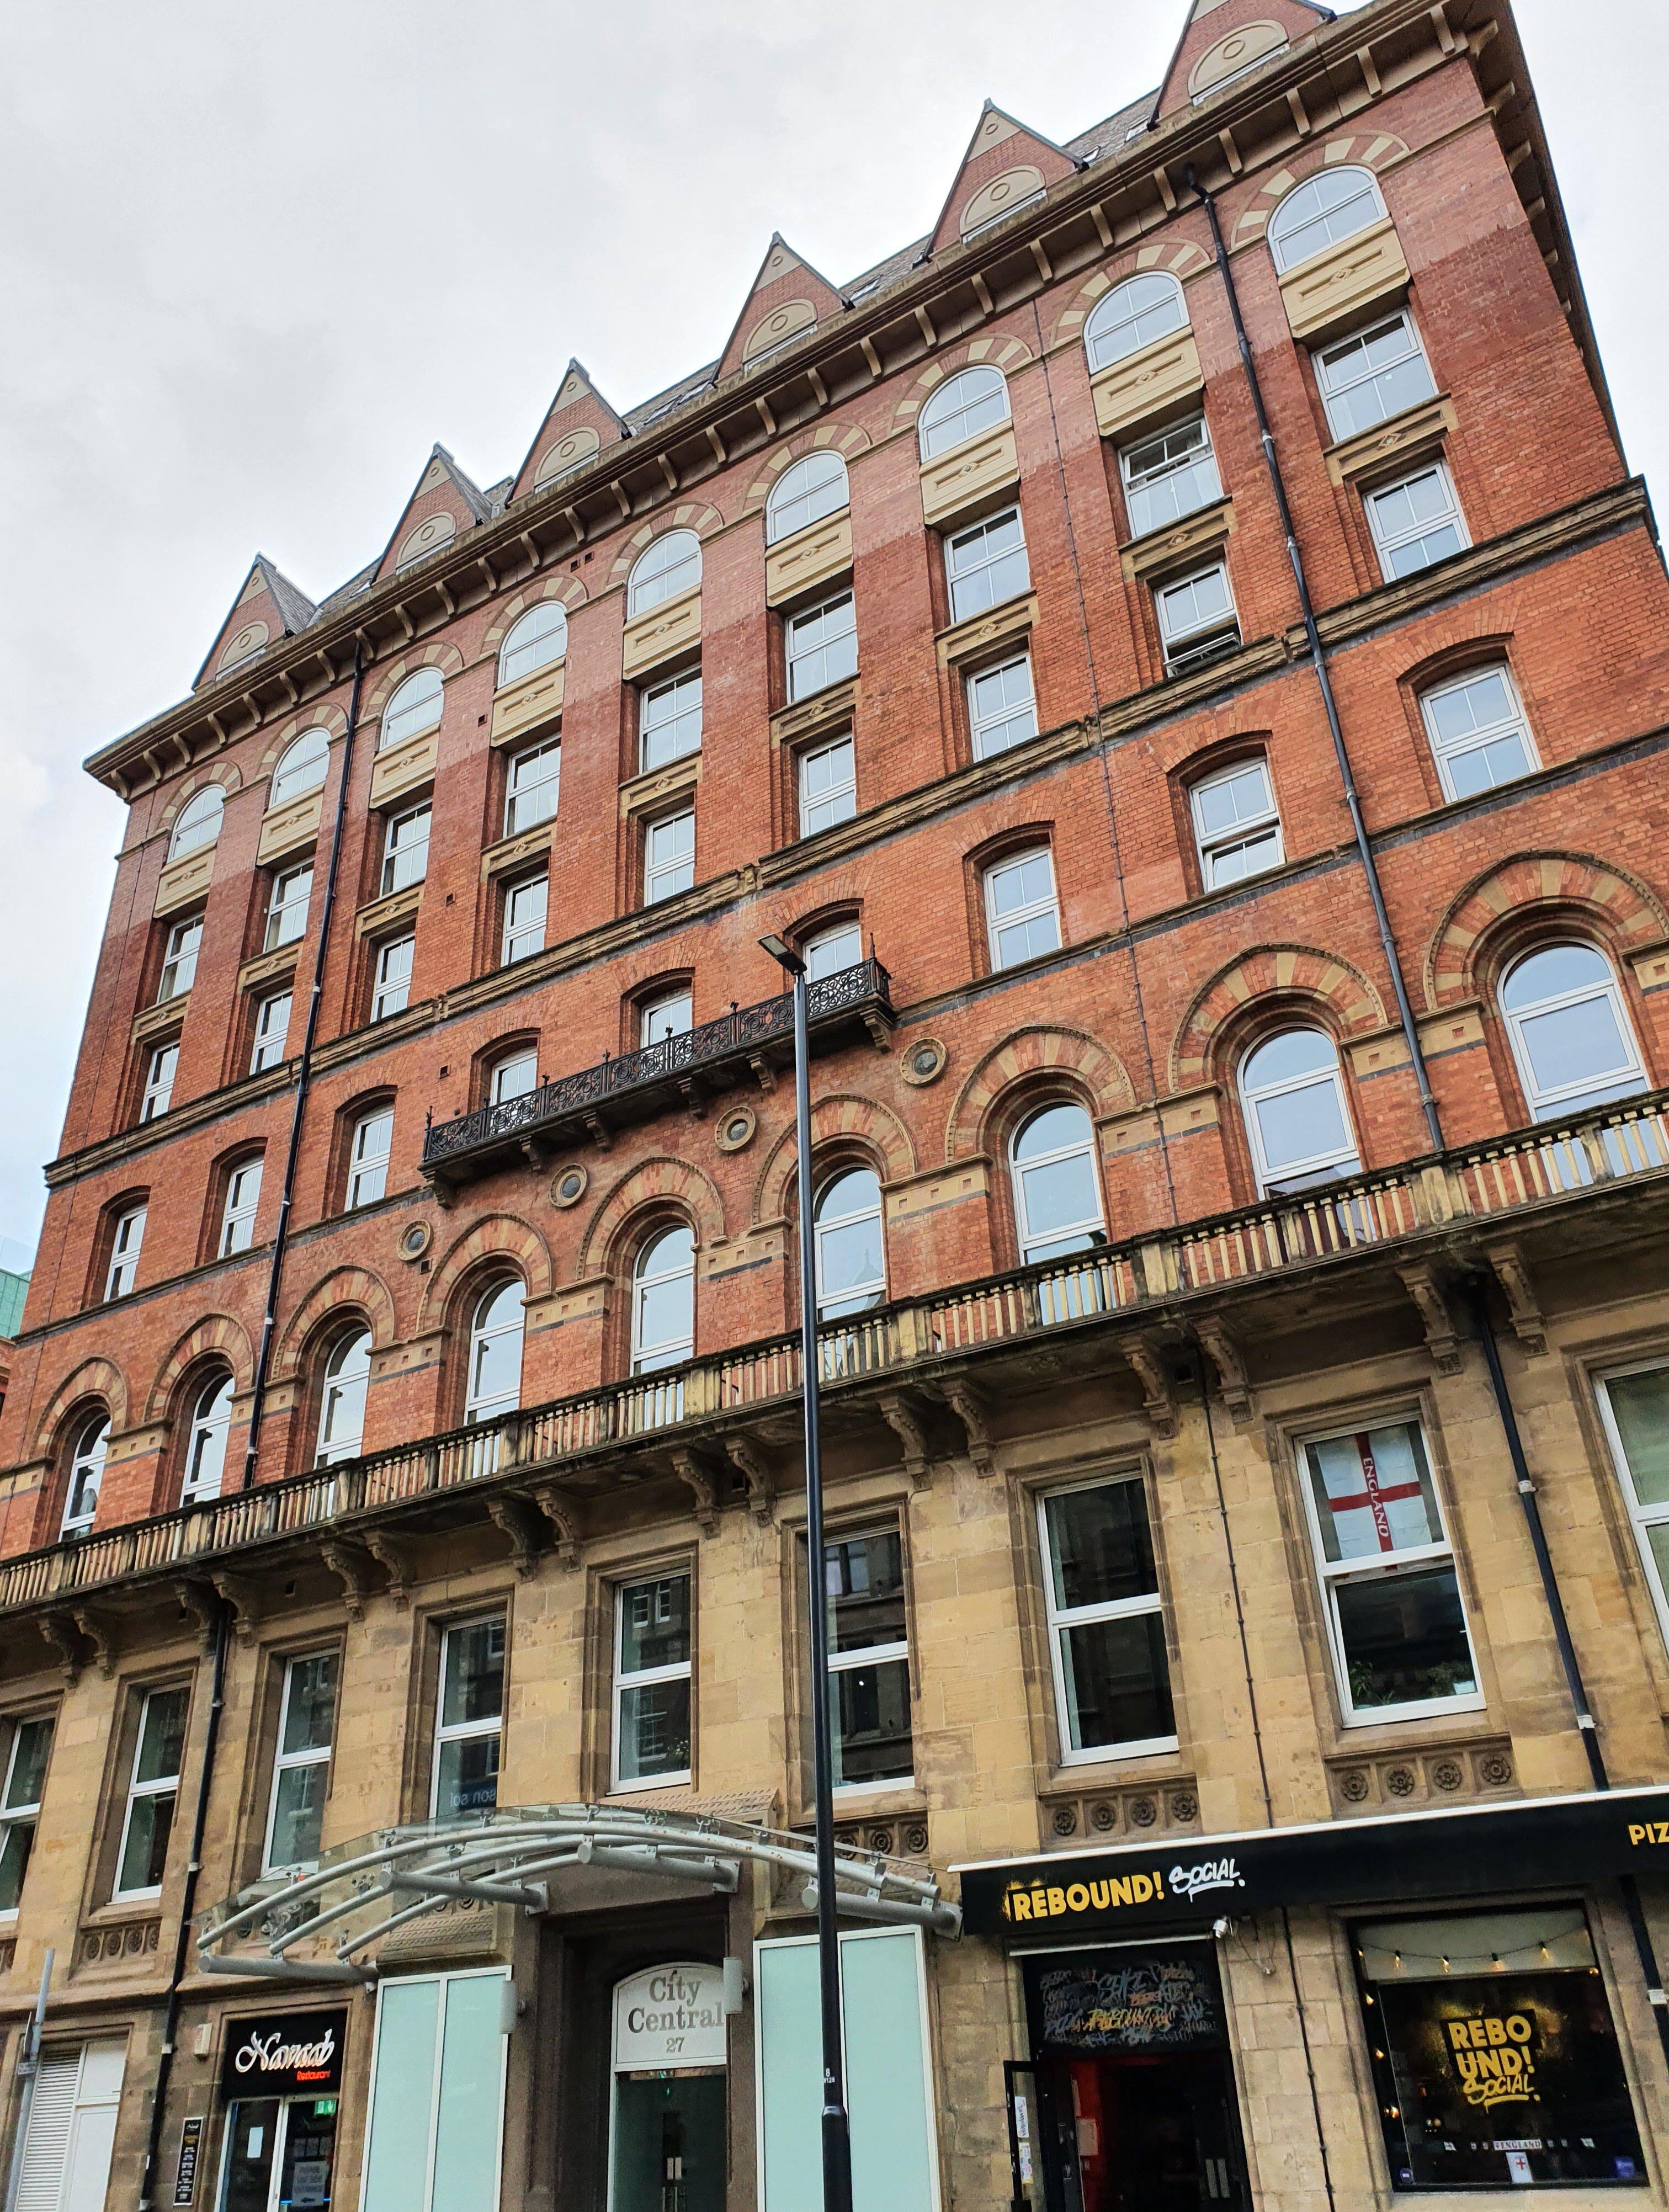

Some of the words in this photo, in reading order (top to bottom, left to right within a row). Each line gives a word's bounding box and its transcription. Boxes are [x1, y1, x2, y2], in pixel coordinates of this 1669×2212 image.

[1363, 1457, 1389, 1537] ENGLAND
[1628, 1822, 1669, 1845] PIZ
[1013, 1871, 1165, 1921] REBOUND!
[650, 1970, 701, 2007] City
[628, 2001, 724, 2034] Central
[1448, 2015, 1532, 2049] REBO
[666, 2036, 685, 2054] 27
[297, 2070, 331, 2081] Restaurant
[826, 2068, 830, 2077] 8
[1455, 2045, 1535, 2080] UND!
[1501, 2141, 1541, 2149] ENGLAND
